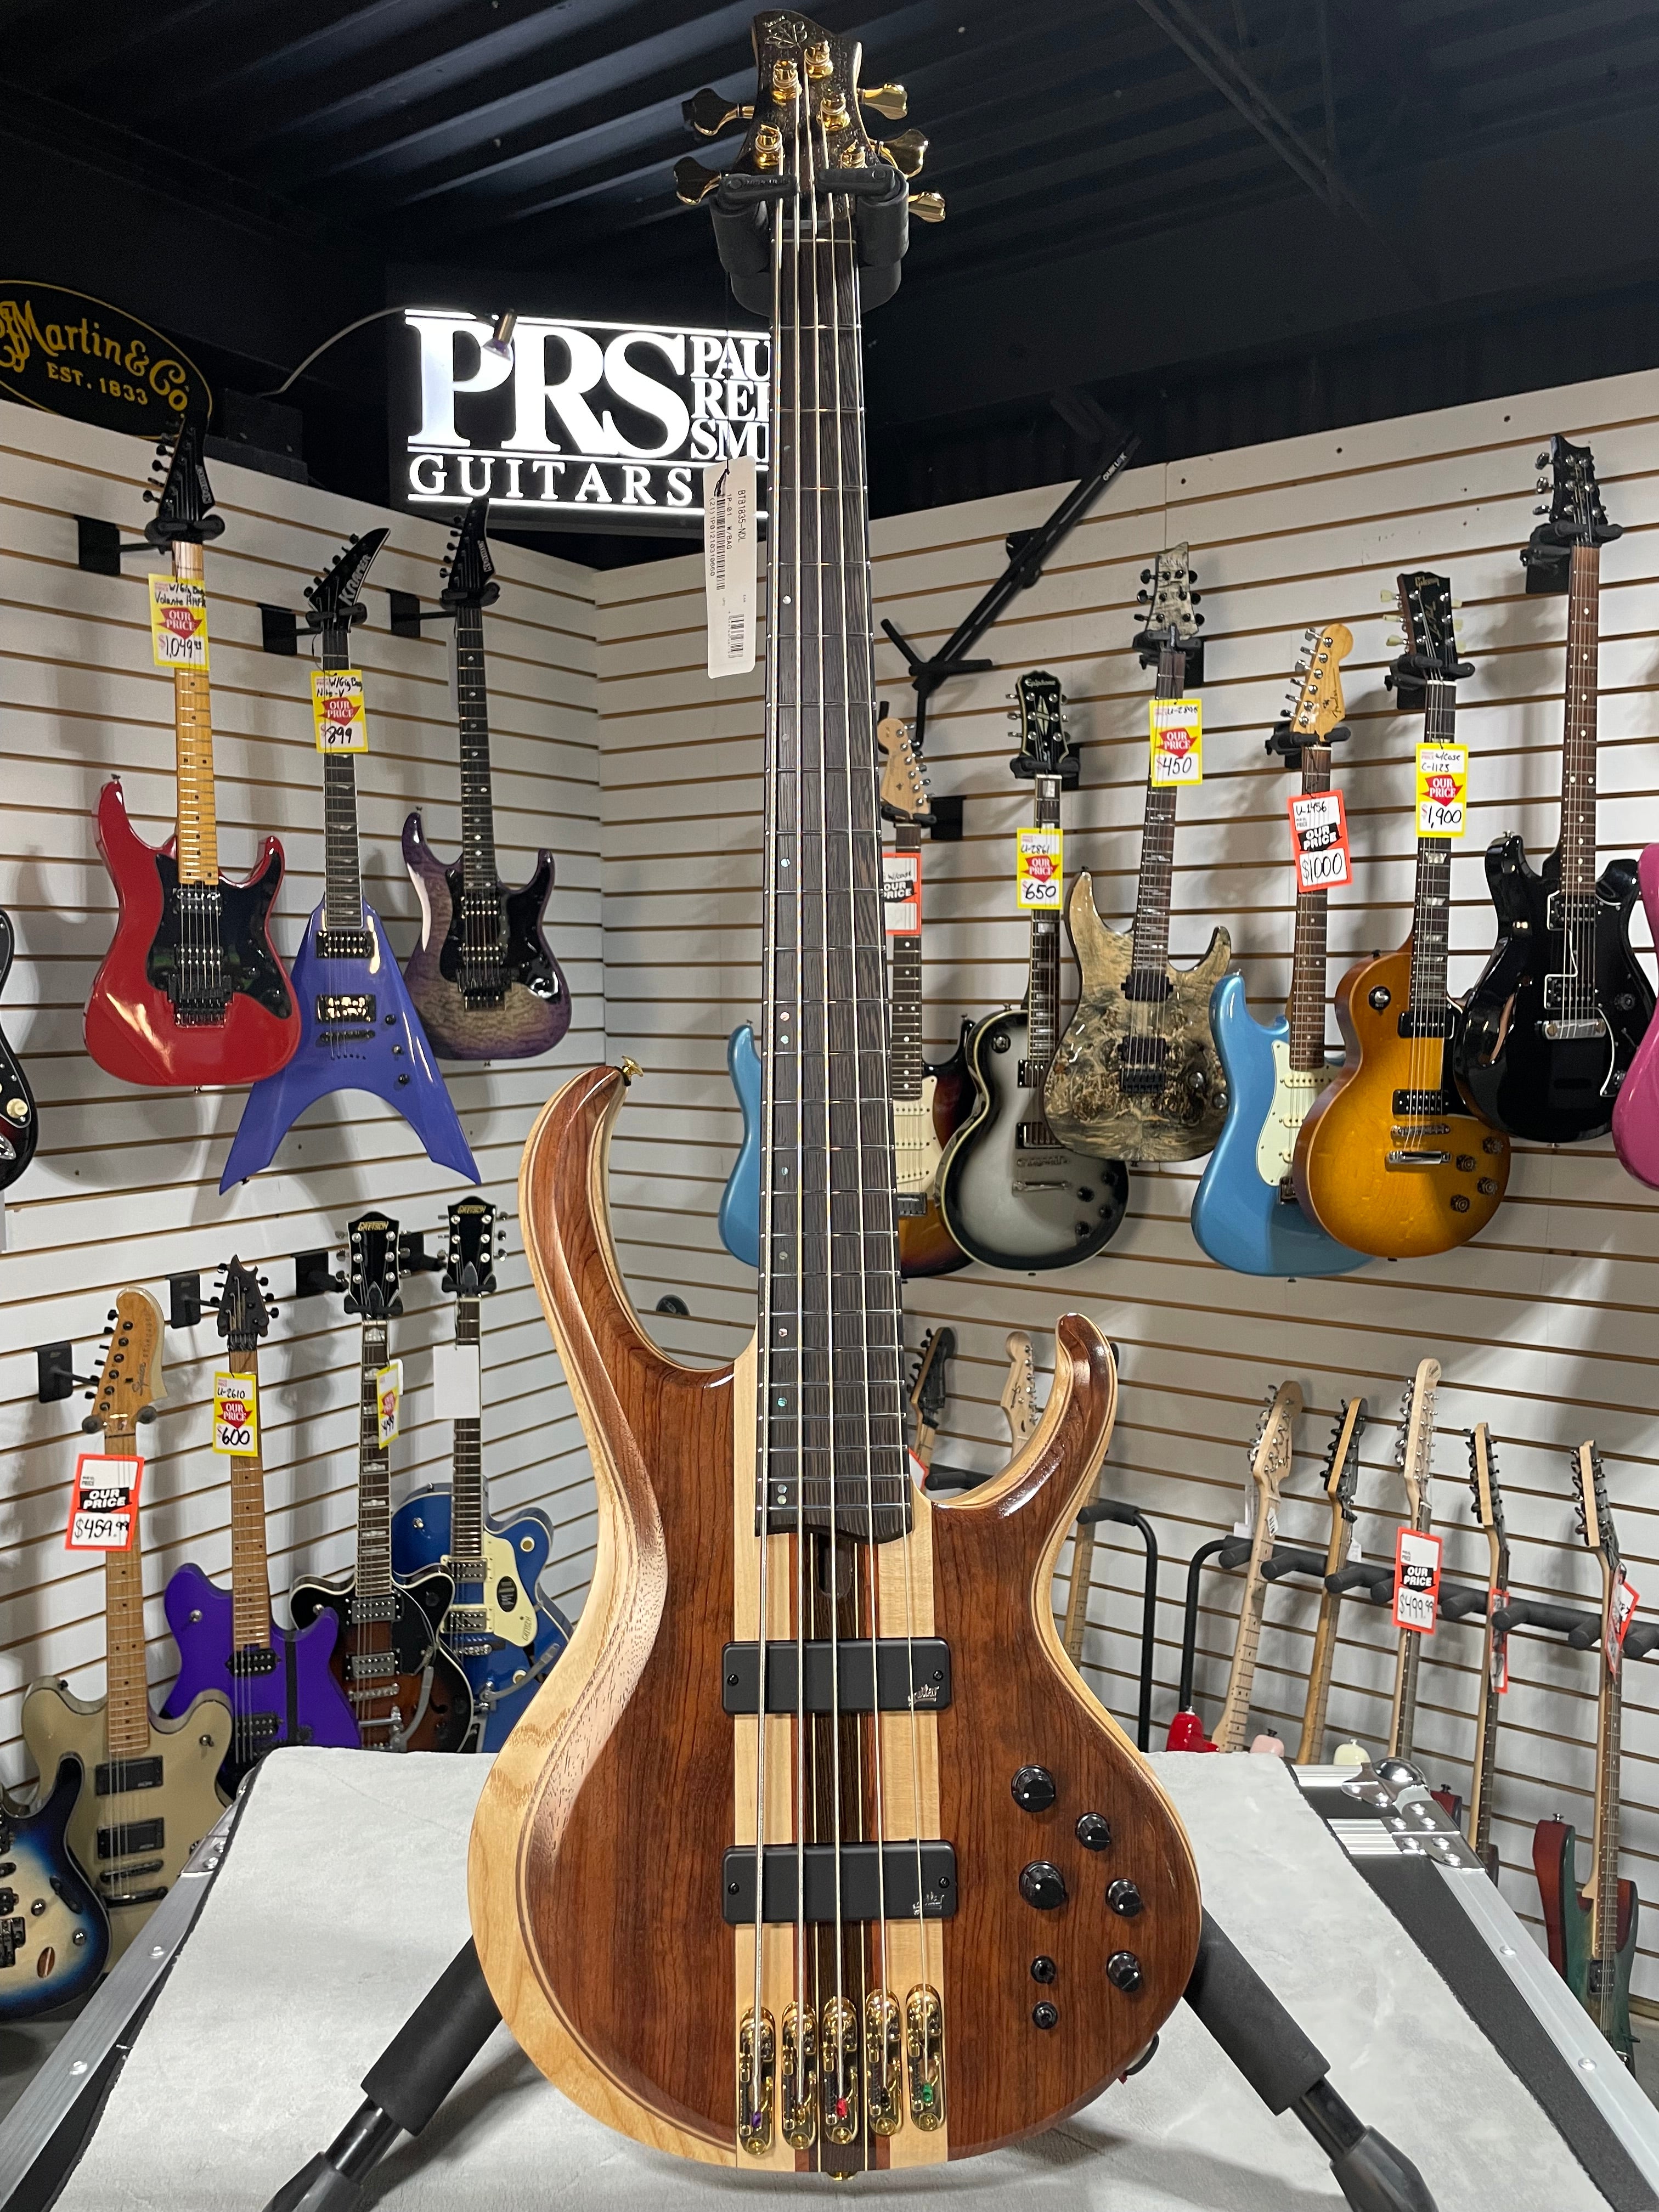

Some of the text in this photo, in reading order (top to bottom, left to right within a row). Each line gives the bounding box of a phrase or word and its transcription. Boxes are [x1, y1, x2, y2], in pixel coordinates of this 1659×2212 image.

[690, 335, 770, 382] PAU
[46, 361, 148, 405] EST. 1833
[405, 315, 690, 459] PRS
[408, 454, 693, 506] GUITARS
[737, 489, 746, 543] BTB1835-NDL
[338, 552, 372, 605] KRAMER
[169, 610, 191, 621] OUR
[166, 619, 196, 631] PRICE
[329, 700, 350, 710] OUR
[327, 708, 354, 718] PRICE
[1166, 731, 1187, 741] OUR
[1164, 740, 1191, 750] PRICE
[1432, 777, 1453, 788] OUR
[1429, 787, 1457, 798] PRICE
[1305, 825, 1330, 840] OUR
[1303, 832, 1338, 851] PRICE
[1031, 857, 1051, 867] OUR
[1302, 852, 1343, 883] $1000
[1029, 866, 1053, 876] PRICE
[883, 882, 907, 892] OUR
[225, 1402, 244, 1413] OUR
[223, 1411, 247, 1422] PRICE
[89, 1488, 120, 1500] OUR
[82, 1496, 127, 1510] PRICE
[1407, 1566, 1429, 1577] OUR
[1403, 1575, 1433, 1587] PRICE
